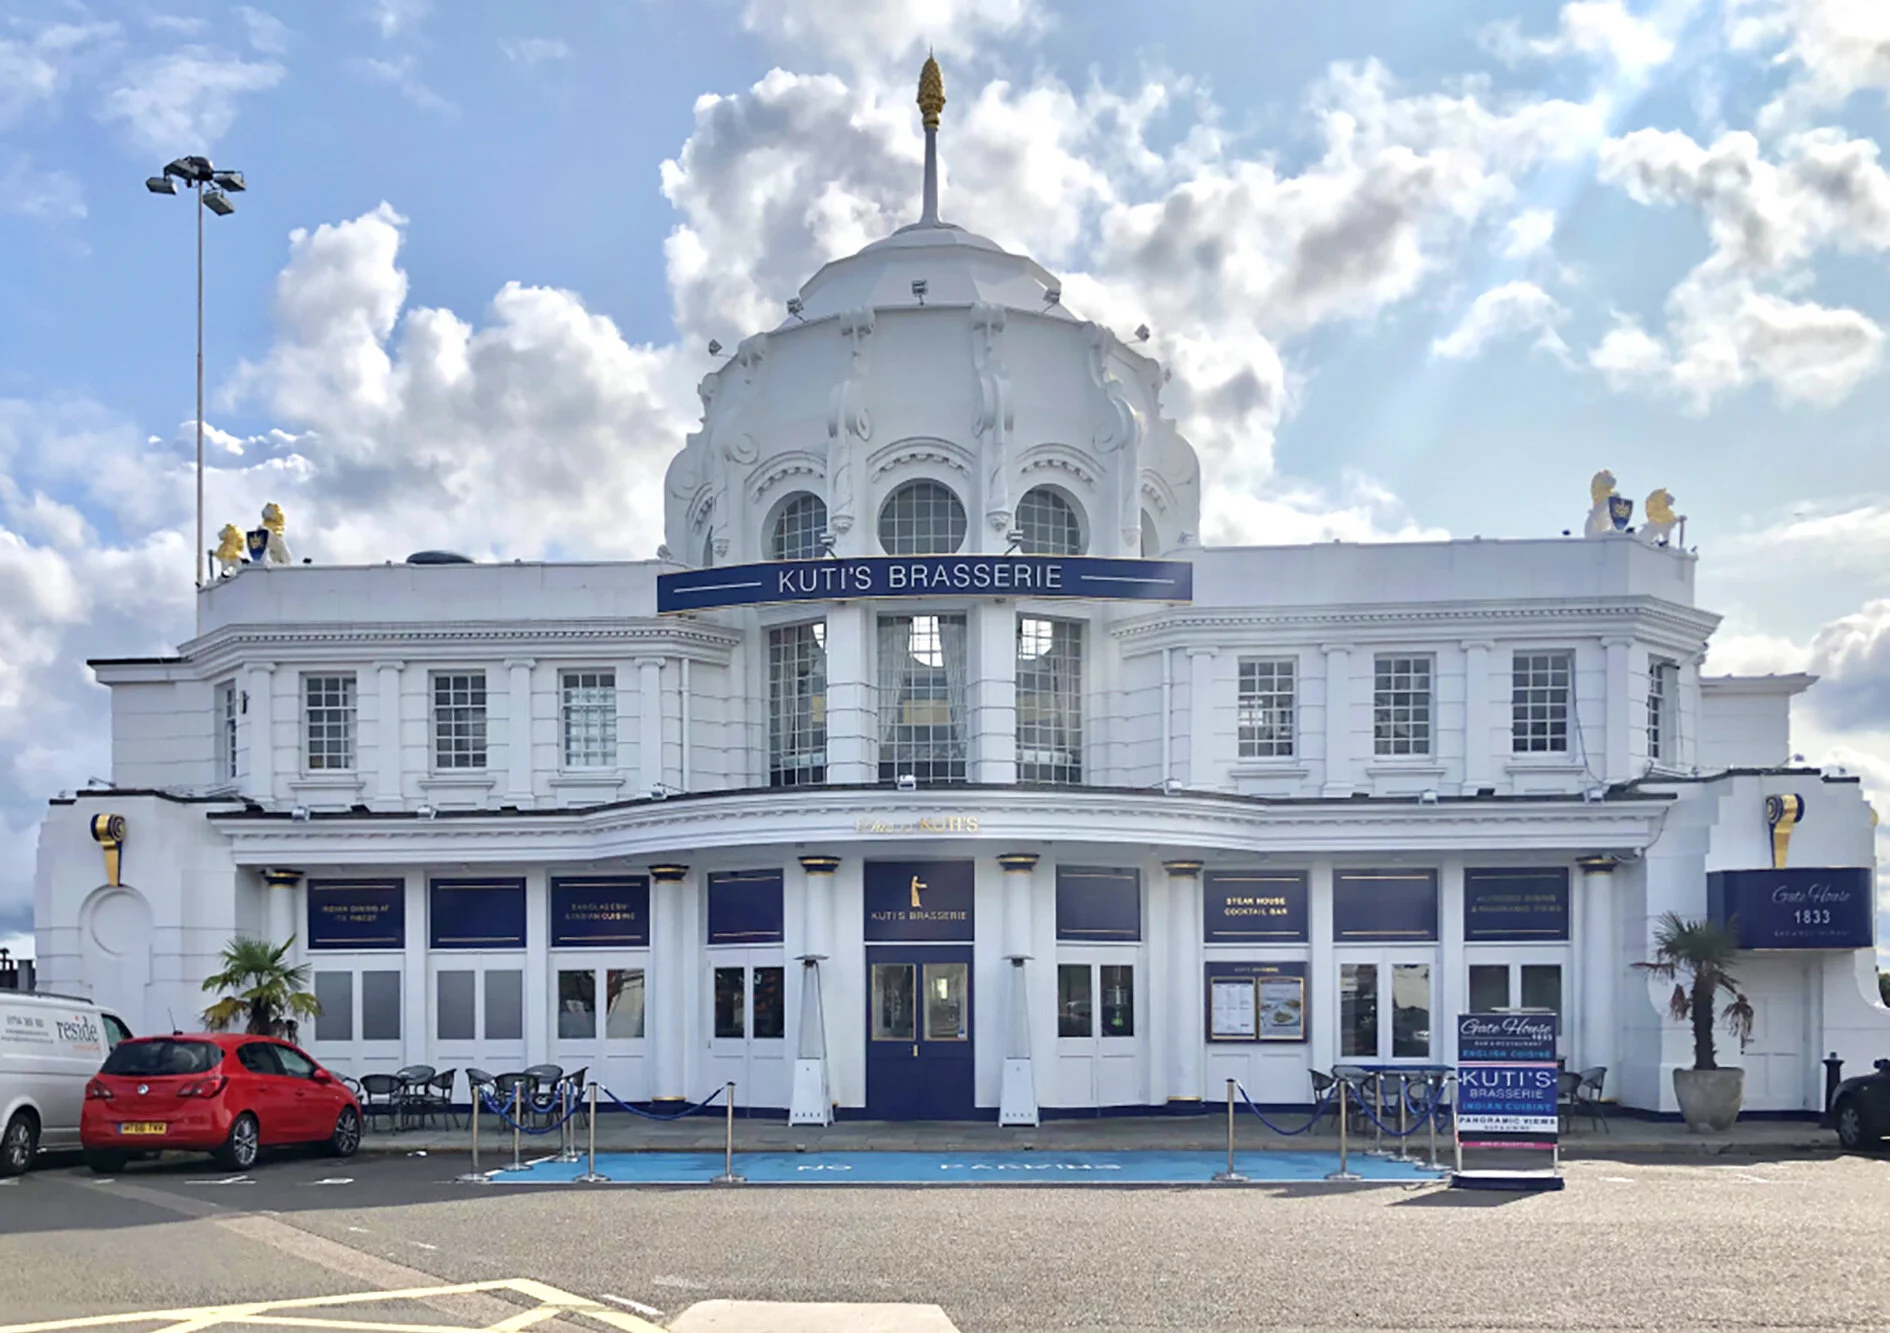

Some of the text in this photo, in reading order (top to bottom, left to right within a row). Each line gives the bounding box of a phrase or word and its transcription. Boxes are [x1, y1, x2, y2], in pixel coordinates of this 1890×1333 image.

[778, 563, 1062, 593] KUTI'S BRASSERIE
[1226, 897, 1285, 905] STEAK HOUSE
[909, 911, 968, 920] BRASSERIE
[1224, 907, 1288, 916] COCKTAIL BAR
[1795, 909, 1830, 924] 1833
[56, 1015, 99, 1042] reside
[1461, 1017, 1552, 1036] Gate House
[1463, 1049, 1552, 1057] ENGLISH CUISINE
[1462, 1071, 1552, 1088] KUTI'S
[1470, 1088, 1544, 1099] BRASSERIE
[1463, 1103, 1553, 1112] INDIAN CUISINE
[1459, 1115, 1556, 1125] PANORAMIC VIEWS
[797, 1163, 852, 1171] NO
